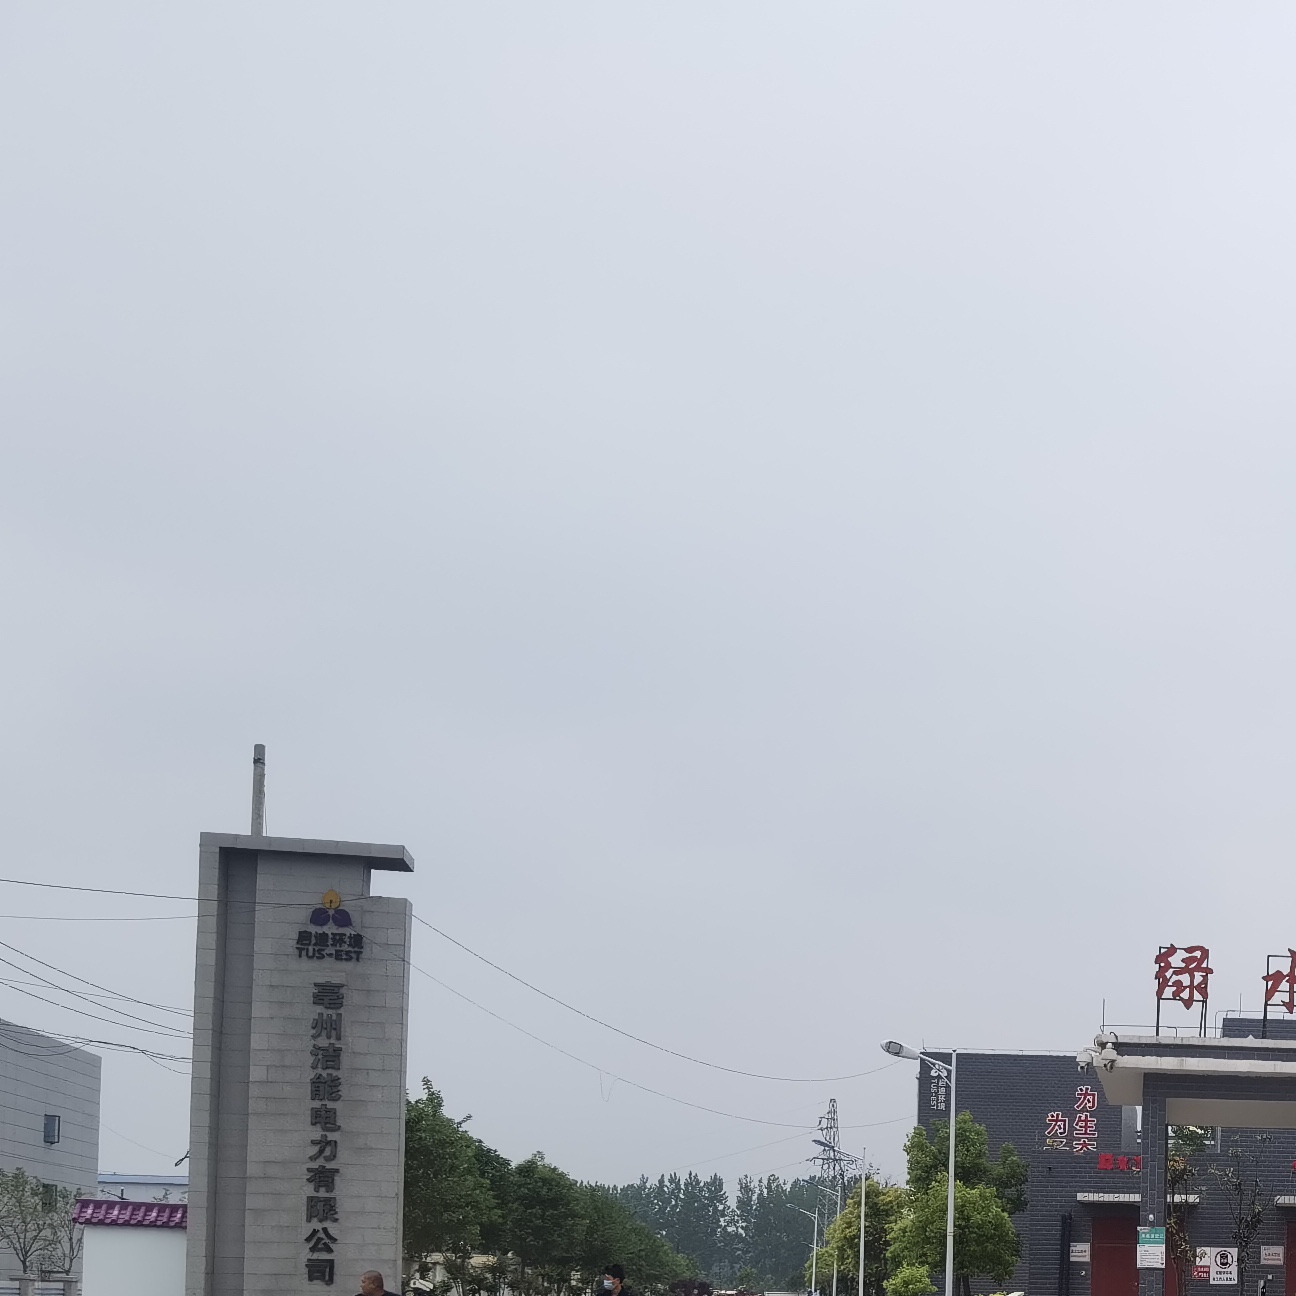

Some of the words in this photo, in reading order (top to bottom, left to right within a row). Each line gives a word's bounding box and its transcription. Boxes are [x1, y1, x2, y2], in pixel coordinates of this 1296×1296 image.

[296, 946, 363, 962] TUS-EST
[304, 981, 345, 1286] 亳州洁能电力有限公司
